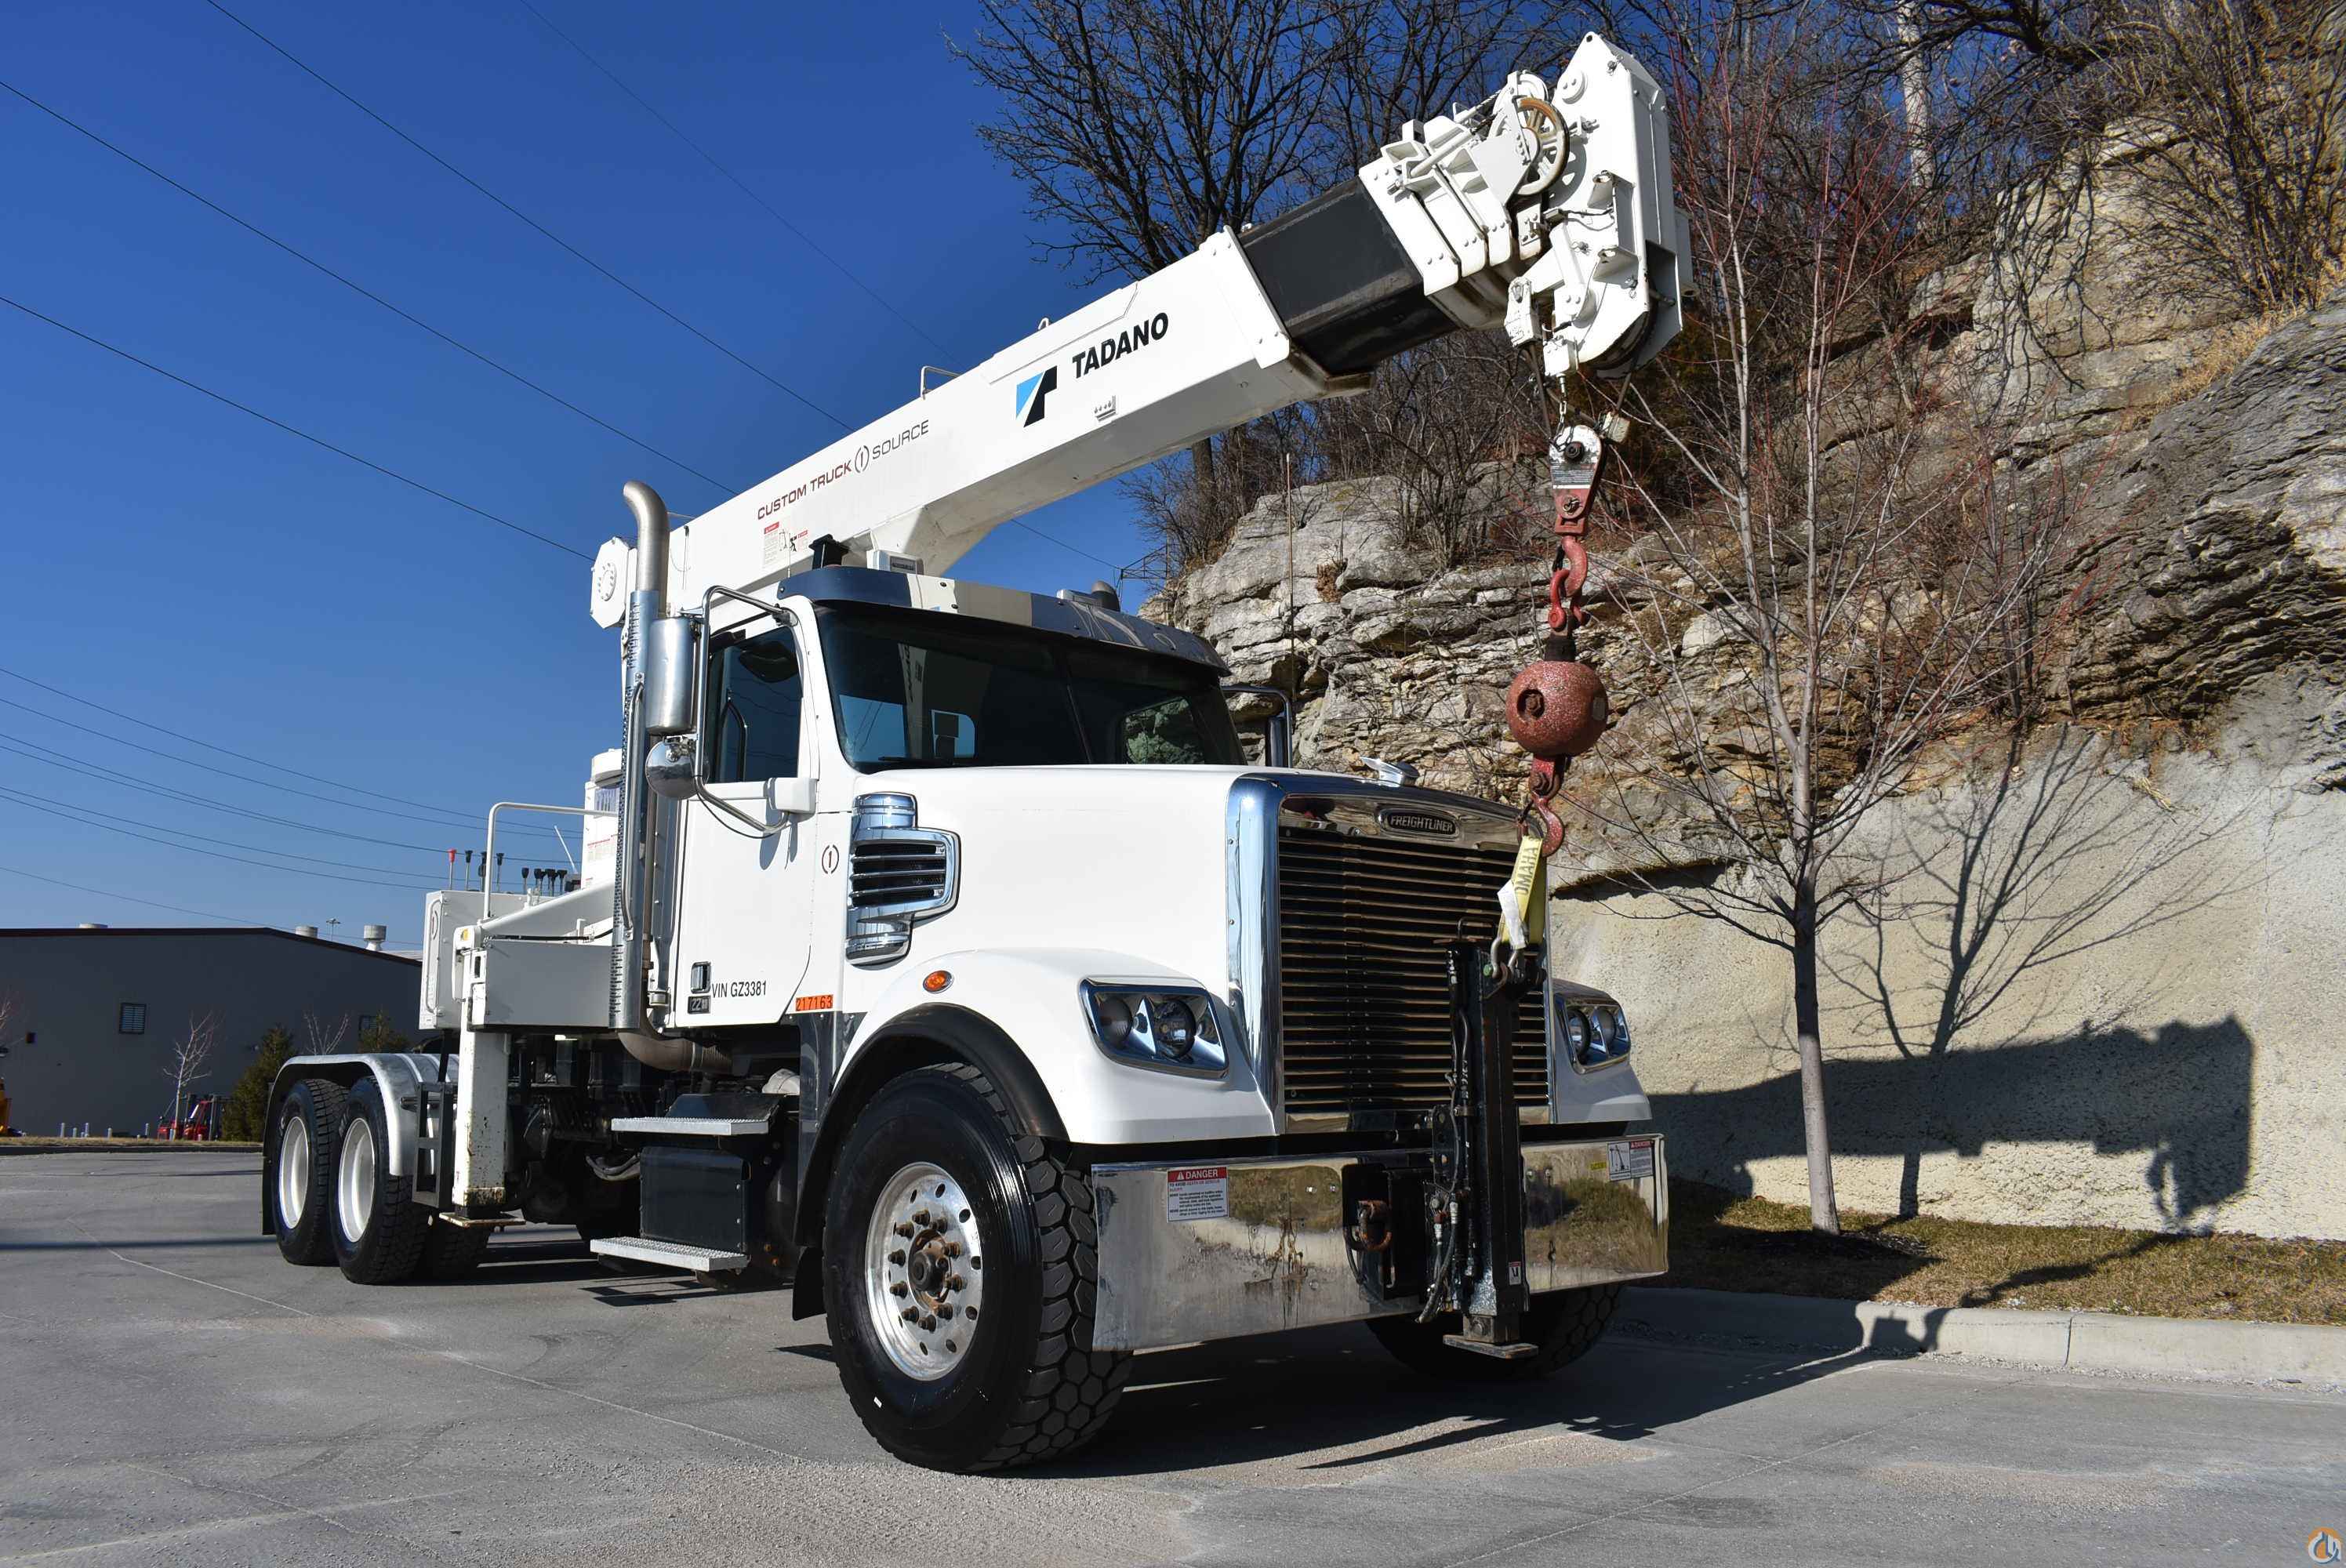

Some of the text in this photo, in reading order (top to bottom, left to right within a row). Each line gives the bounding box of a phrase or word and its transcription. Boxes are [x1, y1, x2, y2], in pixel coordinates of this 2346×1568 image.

[1072, 312, 1169, 379] TADANO
[757, 484, 807, 521] CUSTOM
[810, 460, 852, 492] TRUCK
[872, 419, 929, 460] SOURCE
[1390, 815, 1454, 833] FREIGHTLINER
[1513, 847, 1538, 895] OMAHA
[711, 980, 767, 998] VIN GZ3381
[796, 994, 832, 1011] 217163
[1186, 1169, 1218, 1180] DANGER
